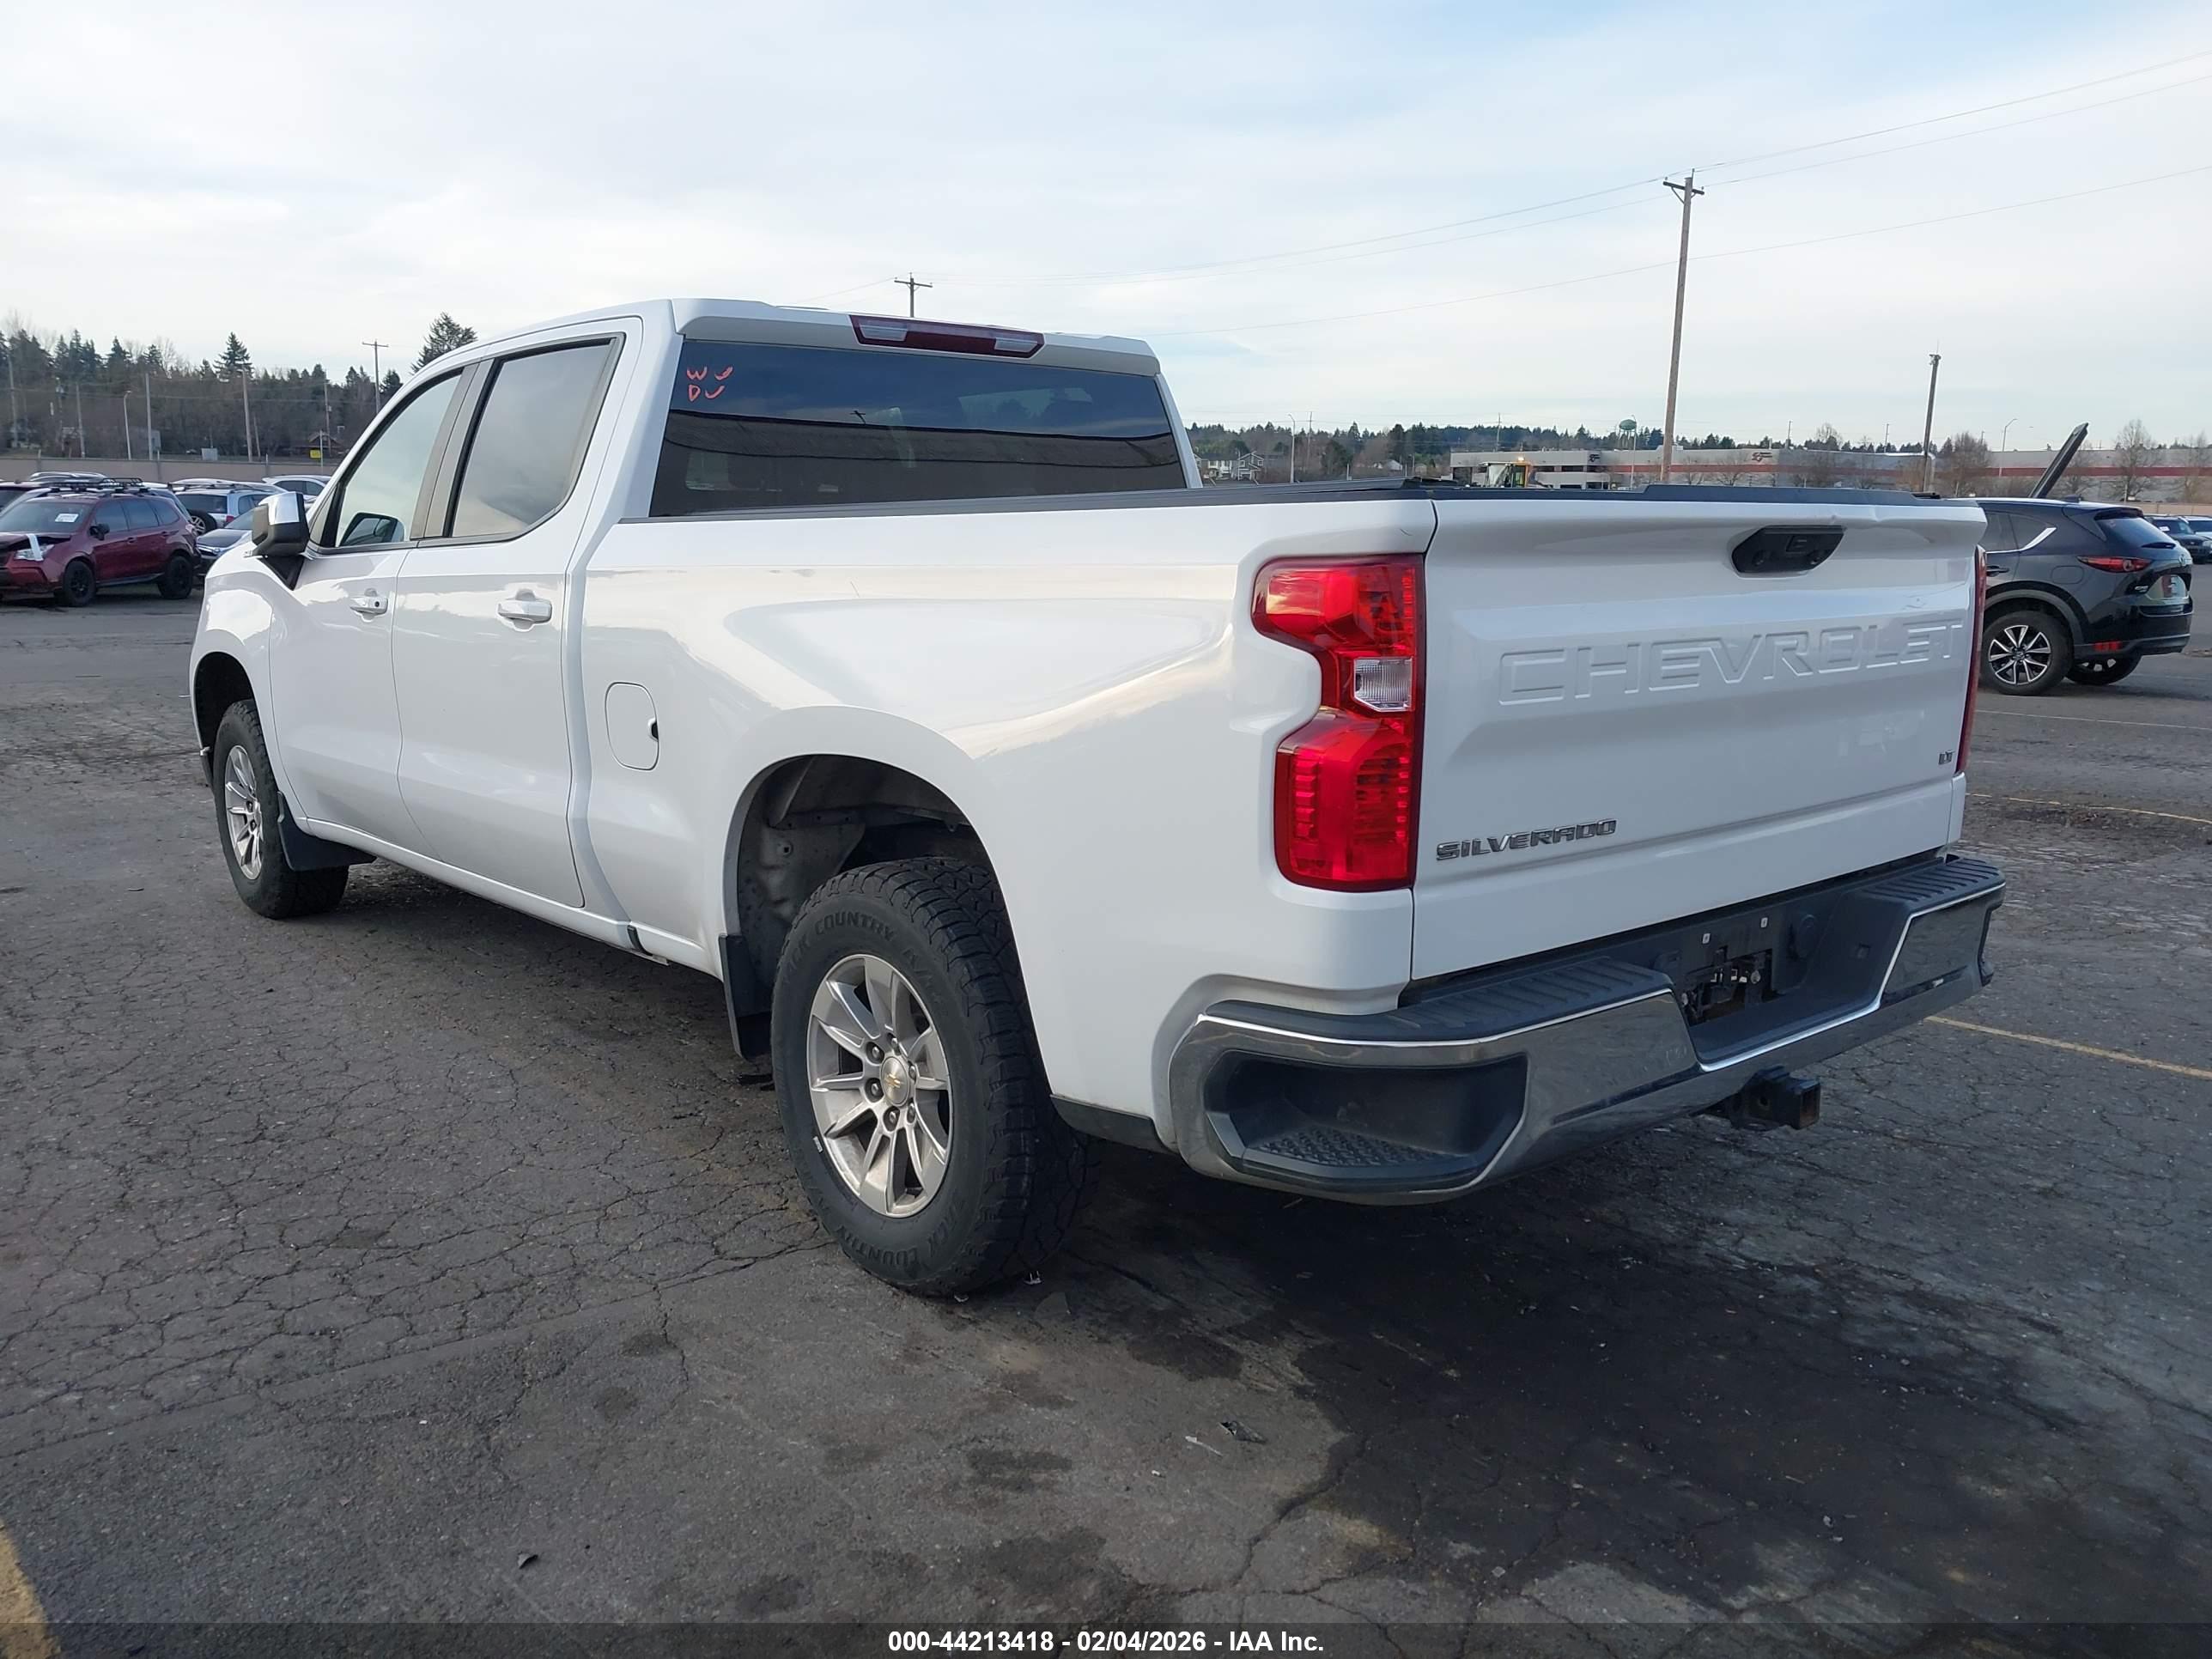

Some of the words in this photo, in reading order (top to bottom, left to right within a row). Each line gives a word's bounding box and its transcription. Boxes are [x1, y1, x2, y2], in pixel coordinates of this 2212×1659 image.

[1498, 617, 1963, 706] CHEVROLET
[1436, 817, 1618, 861] SILVERADO
[816, 911, 895, 941] COUNTRY
